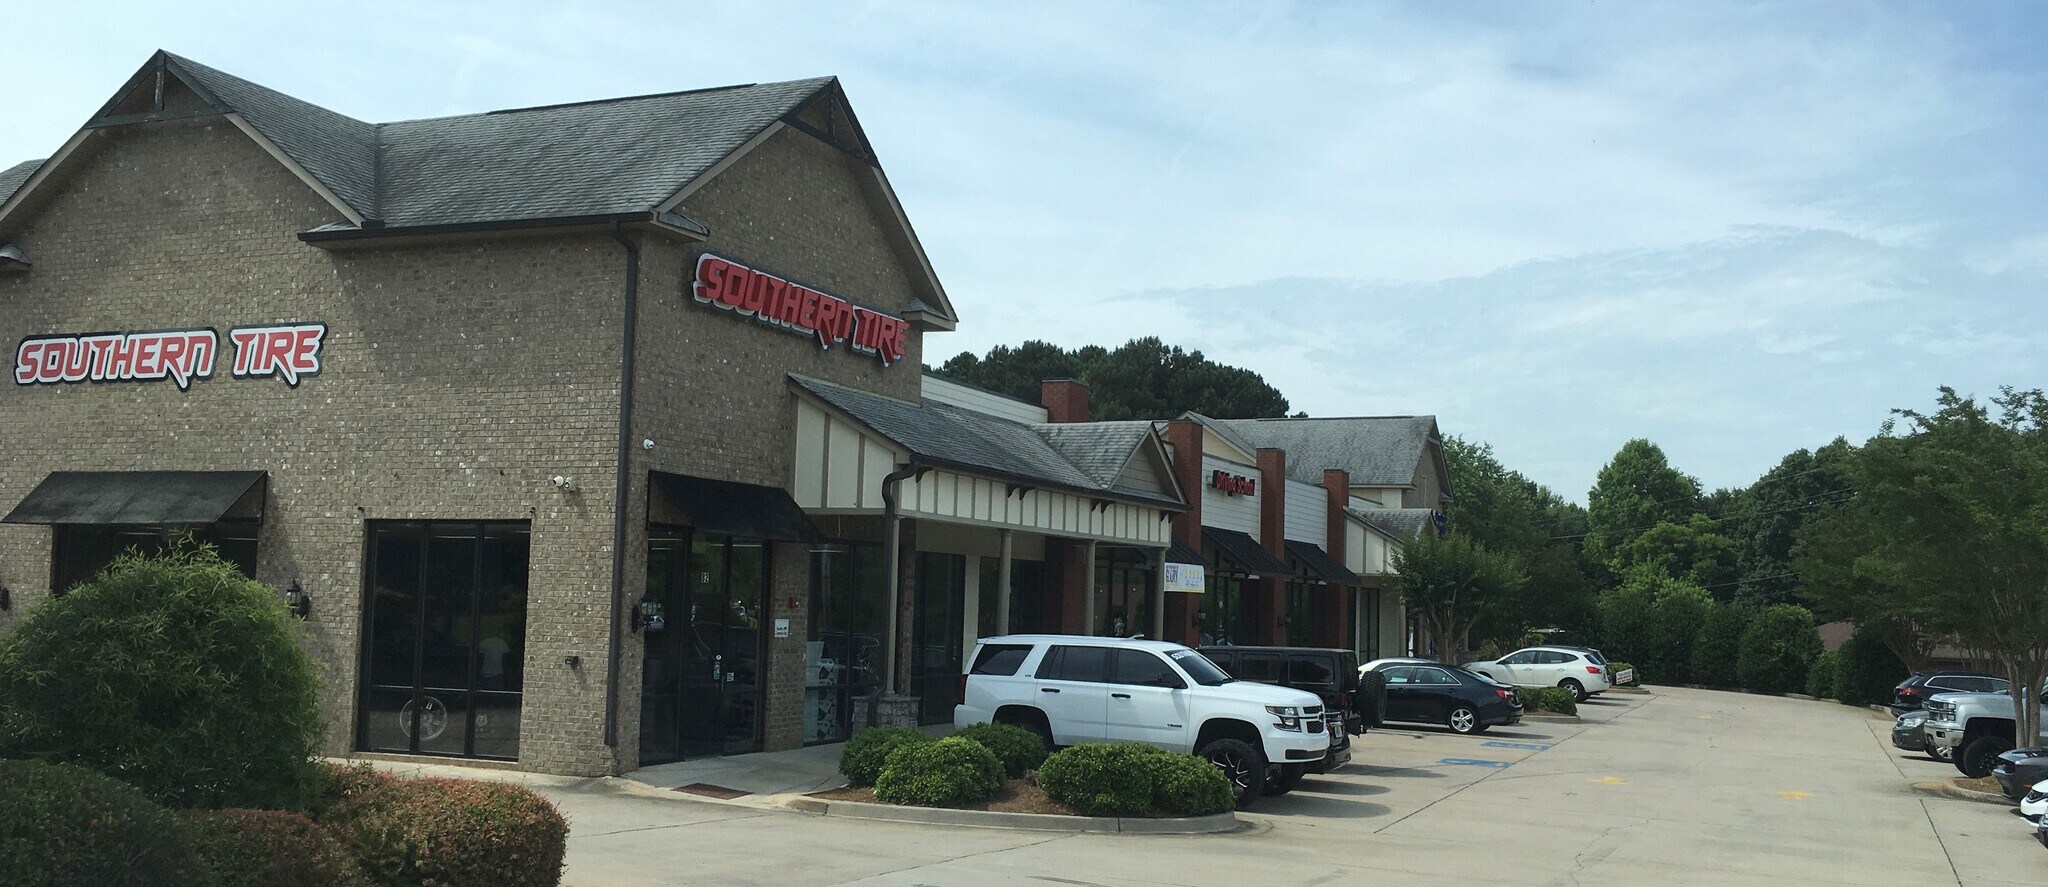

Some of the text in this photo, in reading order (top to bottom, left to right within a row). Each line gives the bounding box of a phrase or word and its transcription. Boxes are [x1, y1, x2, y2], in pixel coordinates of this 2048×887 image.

[692, 253, 910, 367] SOUTHERN TIRE
[16, 325, 325, 388] SOUTHERN TIRE
